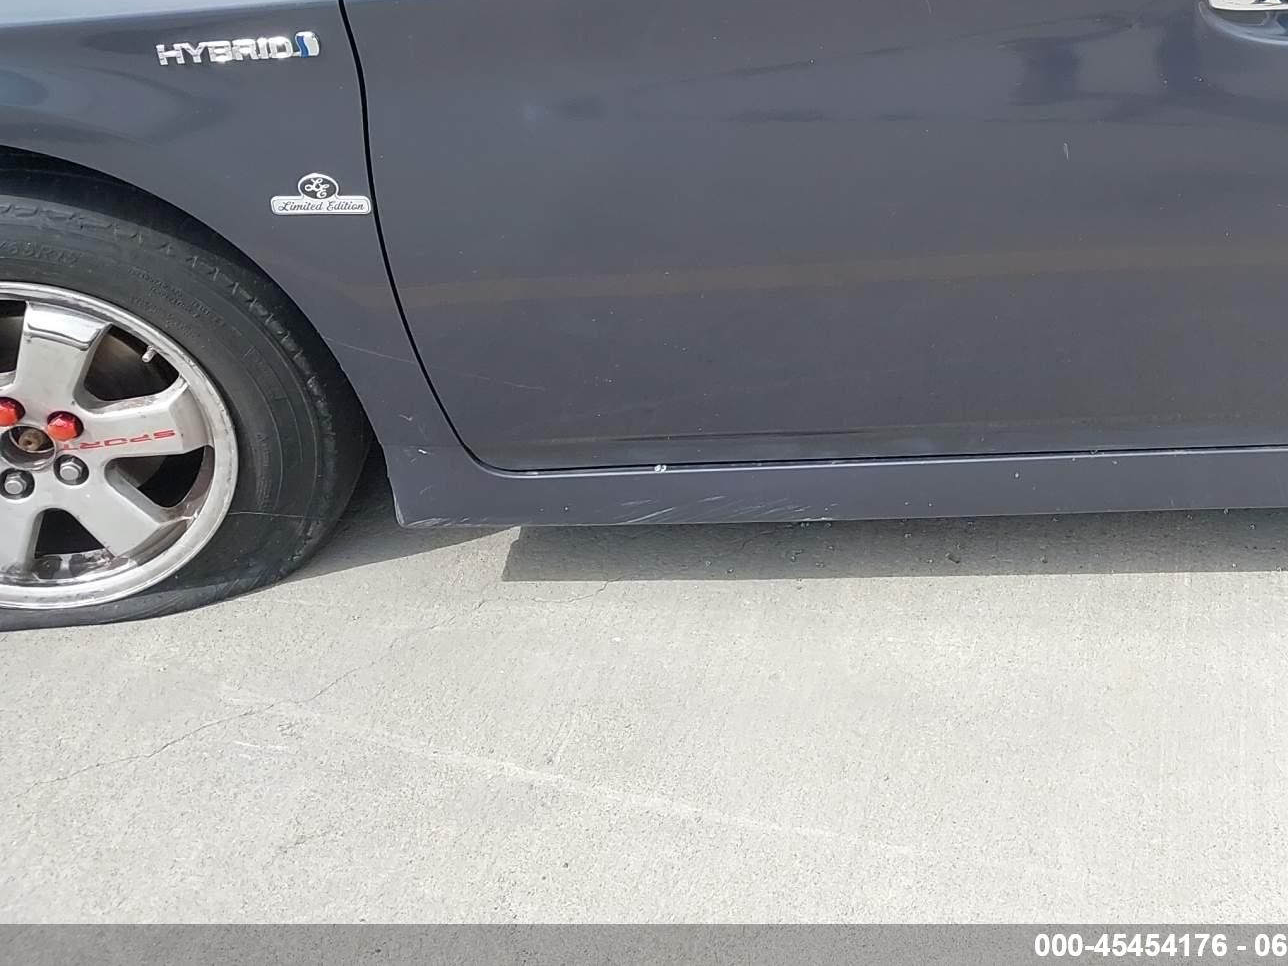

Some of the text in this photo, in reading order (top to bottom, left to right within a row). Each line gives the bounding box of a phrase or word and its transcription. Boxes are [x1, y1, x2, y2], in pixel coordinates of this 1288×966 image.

[156, 36, 292, 66] HYBRID
[278, 200, 365, 212] Limited Edition
[62, 429, 176, 452] SPORT
